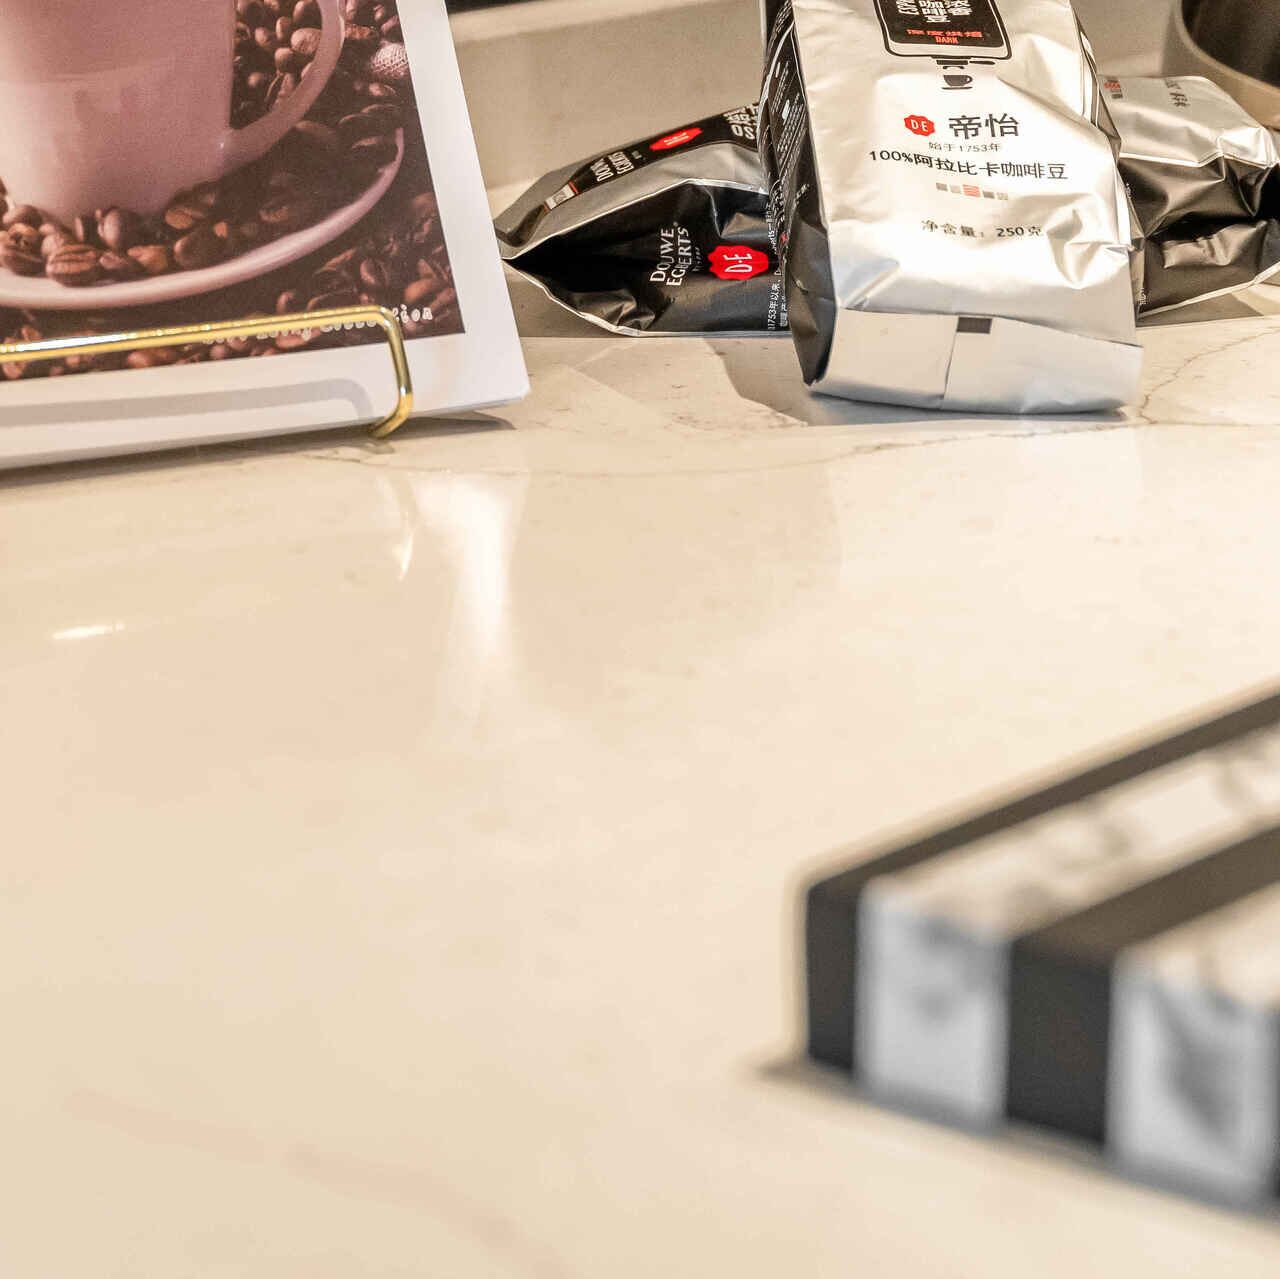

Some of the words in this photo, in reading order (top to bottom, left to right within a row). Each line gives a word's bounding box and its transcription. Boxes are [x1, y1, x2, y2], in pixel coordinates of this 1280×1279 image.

[935, 36, 959, 45] DARK
[948, 112, 1020, 140] 帝怡
[869, 149, 1069, 180] 100%阿拉比卡咖啡豆
[649, 227, 675, 282] DOUWE
